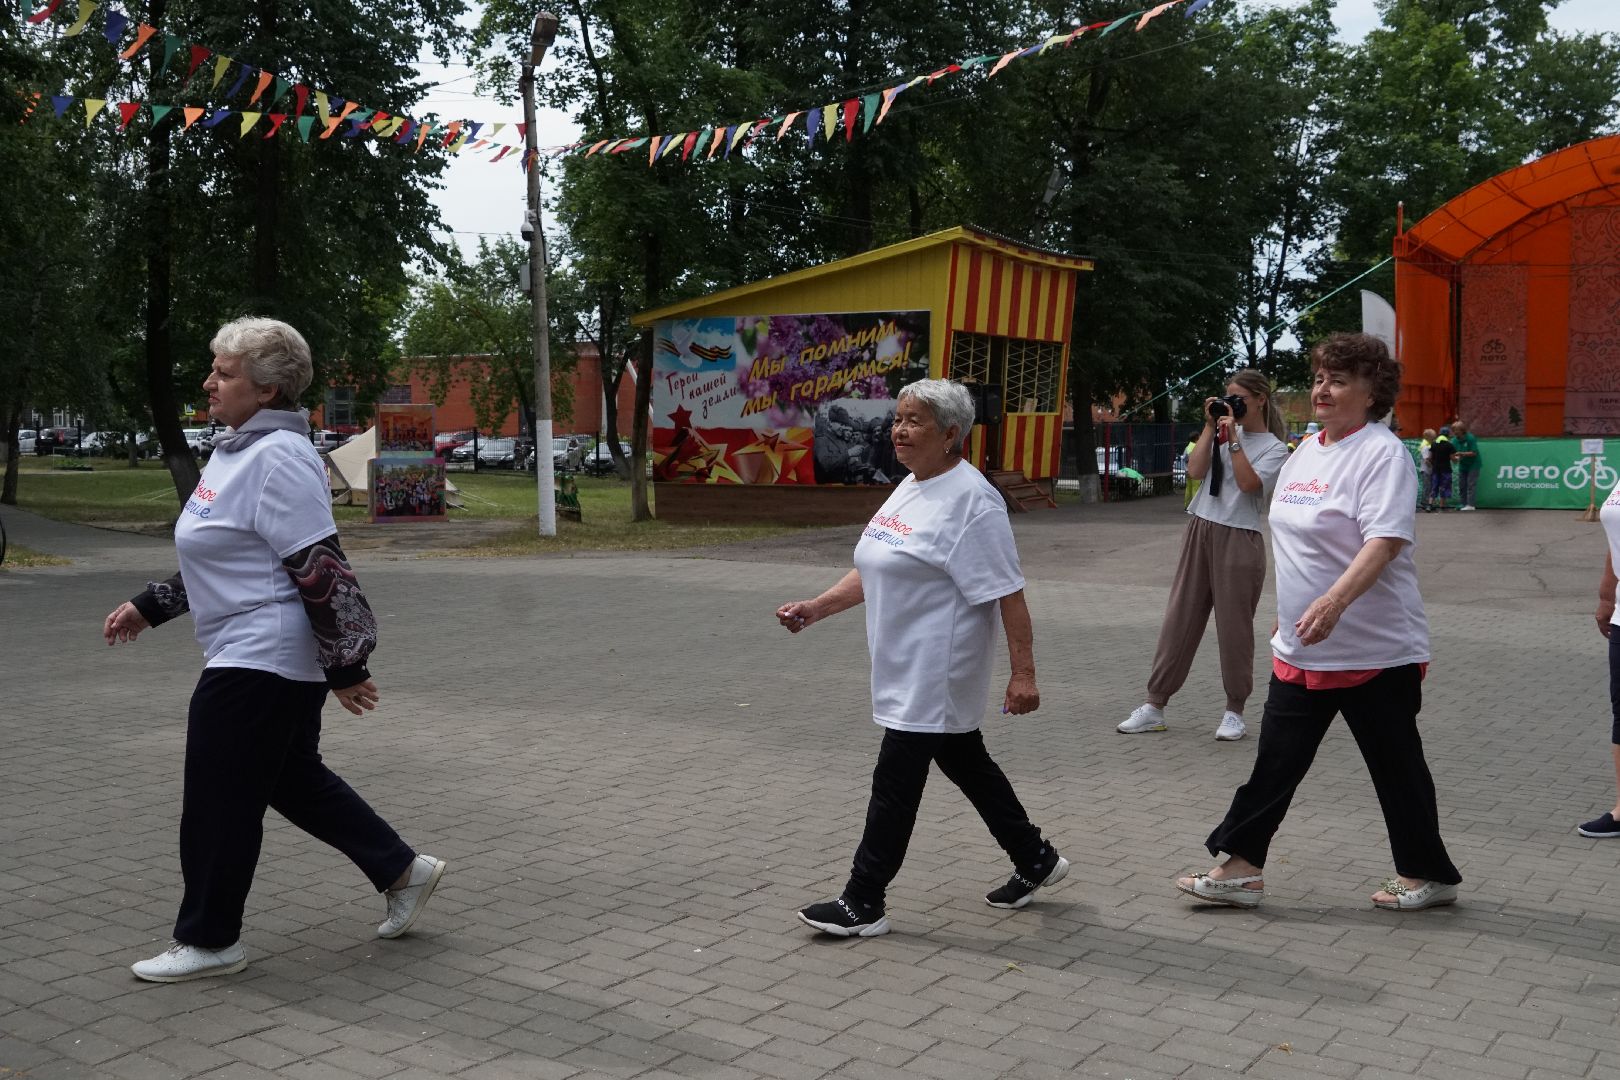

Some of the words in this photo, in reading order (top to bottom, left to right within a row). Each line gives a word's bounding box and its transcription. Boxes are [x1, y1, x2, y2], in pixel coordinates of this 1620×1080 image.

[740, 390, 778, 418] мы
[790, 341, 912, 401] гордимся!
[749, 355, 786, 383] Мы
[665, 371, 698, 400] Герои
[689, 373, 726, 400] нашей
[702, 387, 737, 420] земли
[1497, 465, 1560, 479] лето
